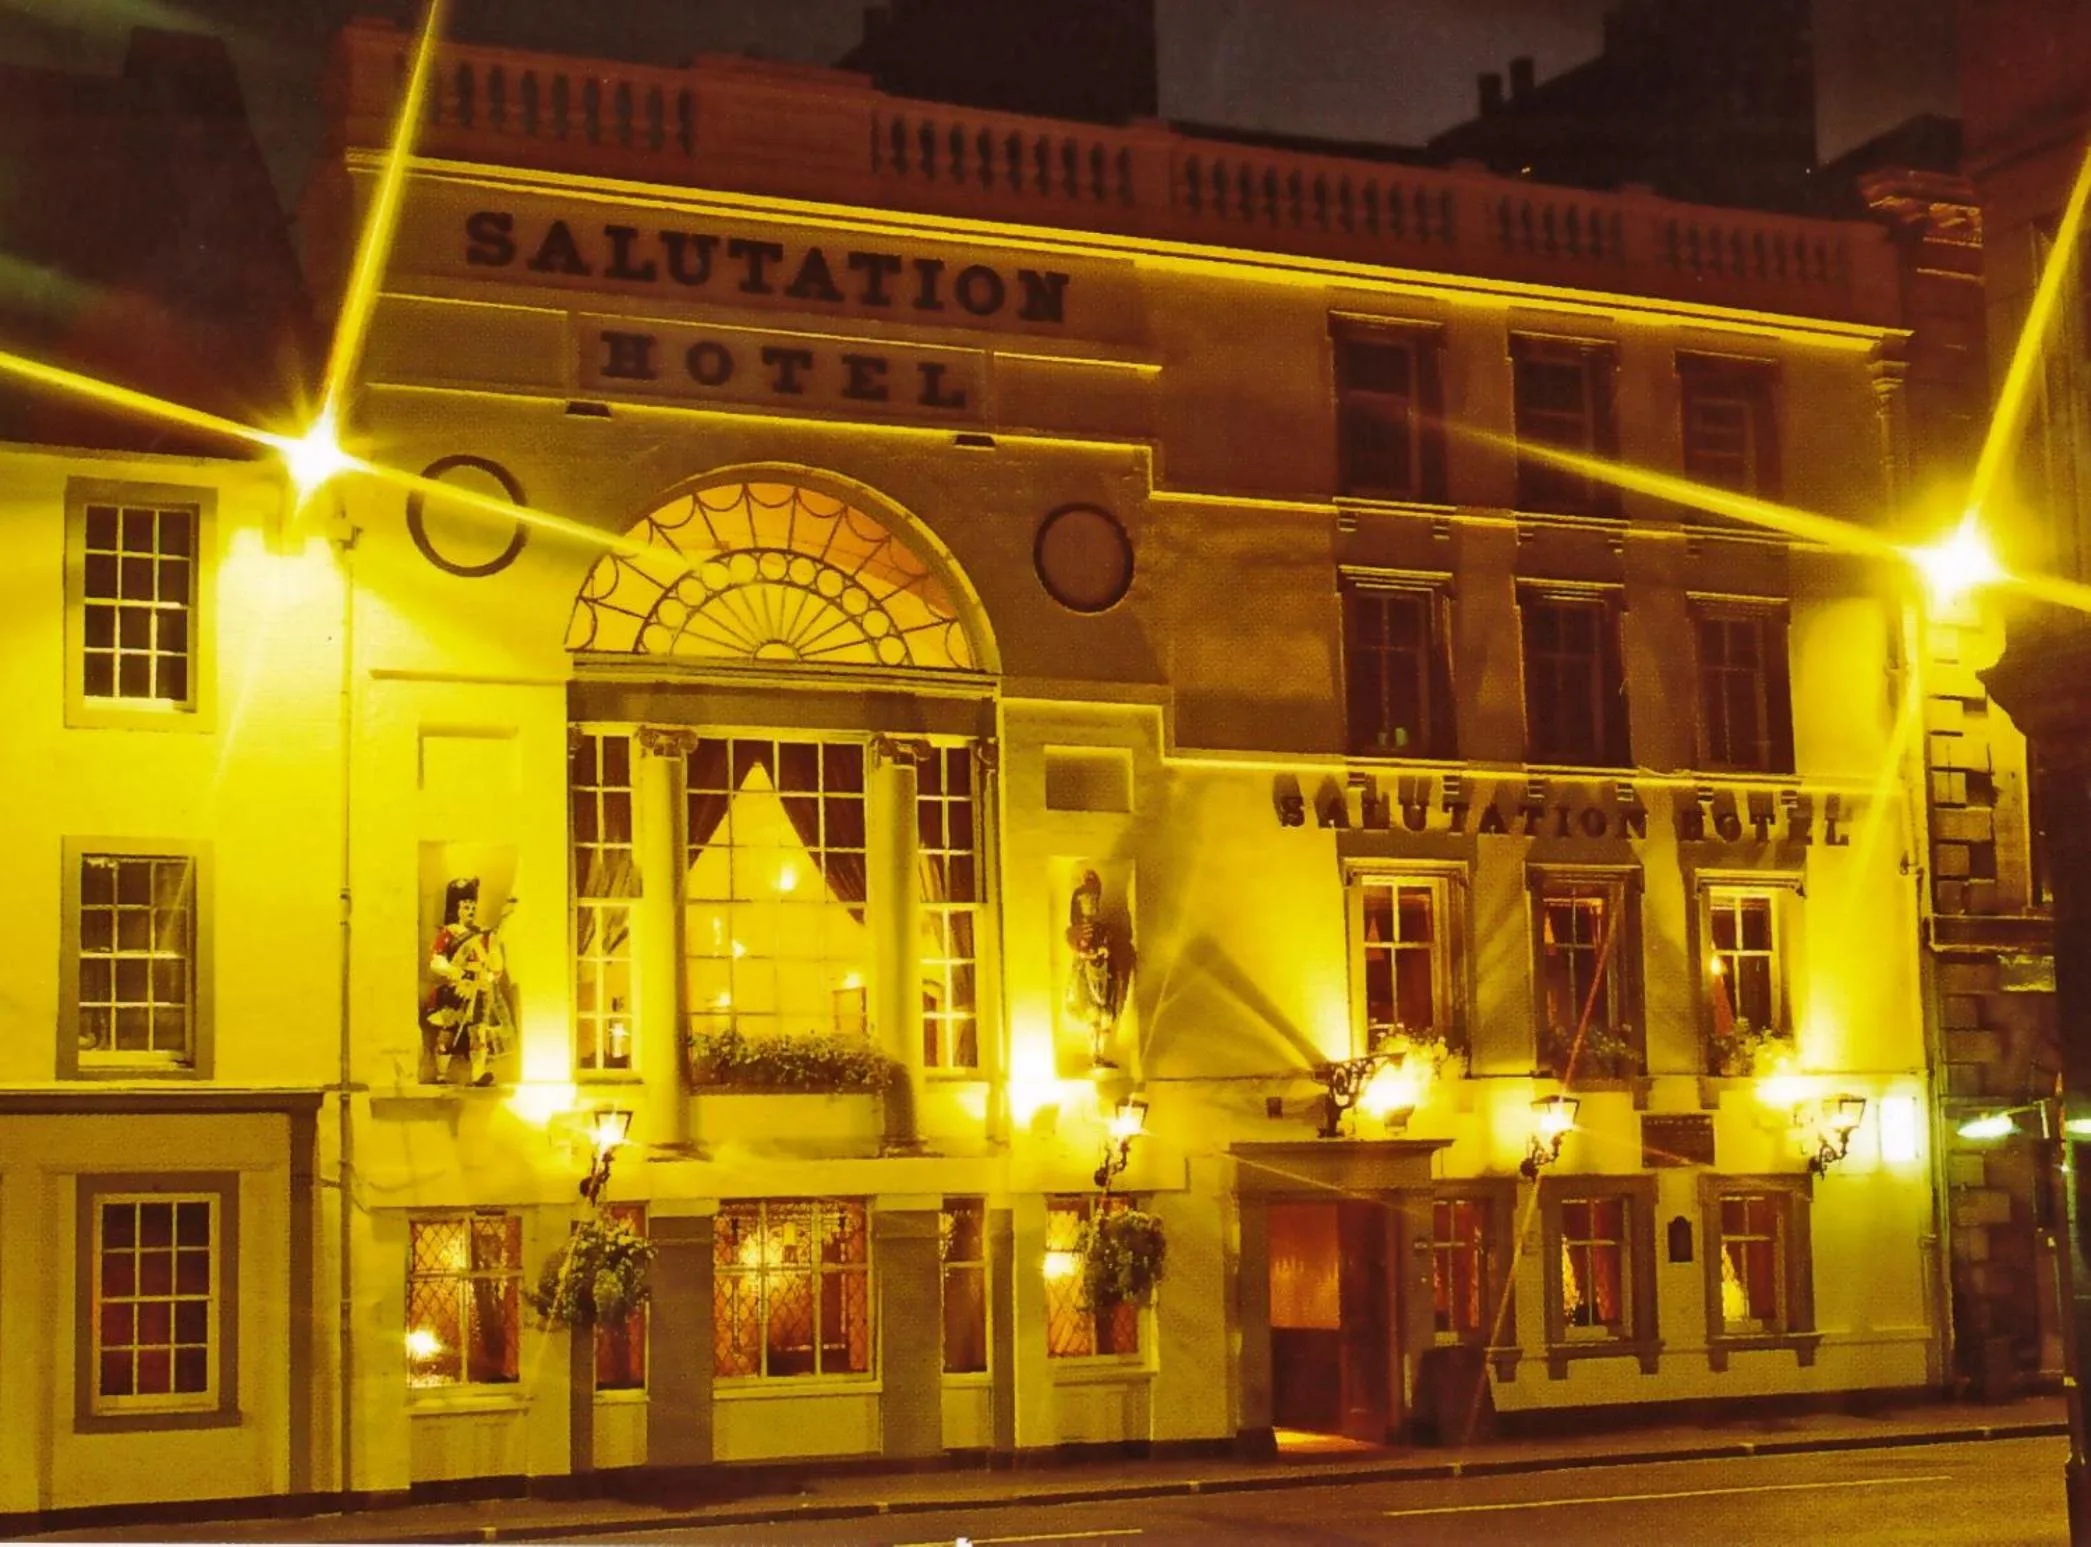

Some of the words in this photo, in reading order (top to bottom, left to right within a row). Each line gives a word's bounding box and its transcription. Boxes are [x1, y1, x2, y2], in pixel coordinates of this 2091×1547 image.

[464, 210, 1069, 323] SALUTATION
[601, 331, 966, 408] HOTEL
[1279, 796, 1649, 841] SALUTATION
[1678, 808, 1850, 847] HOTEL
